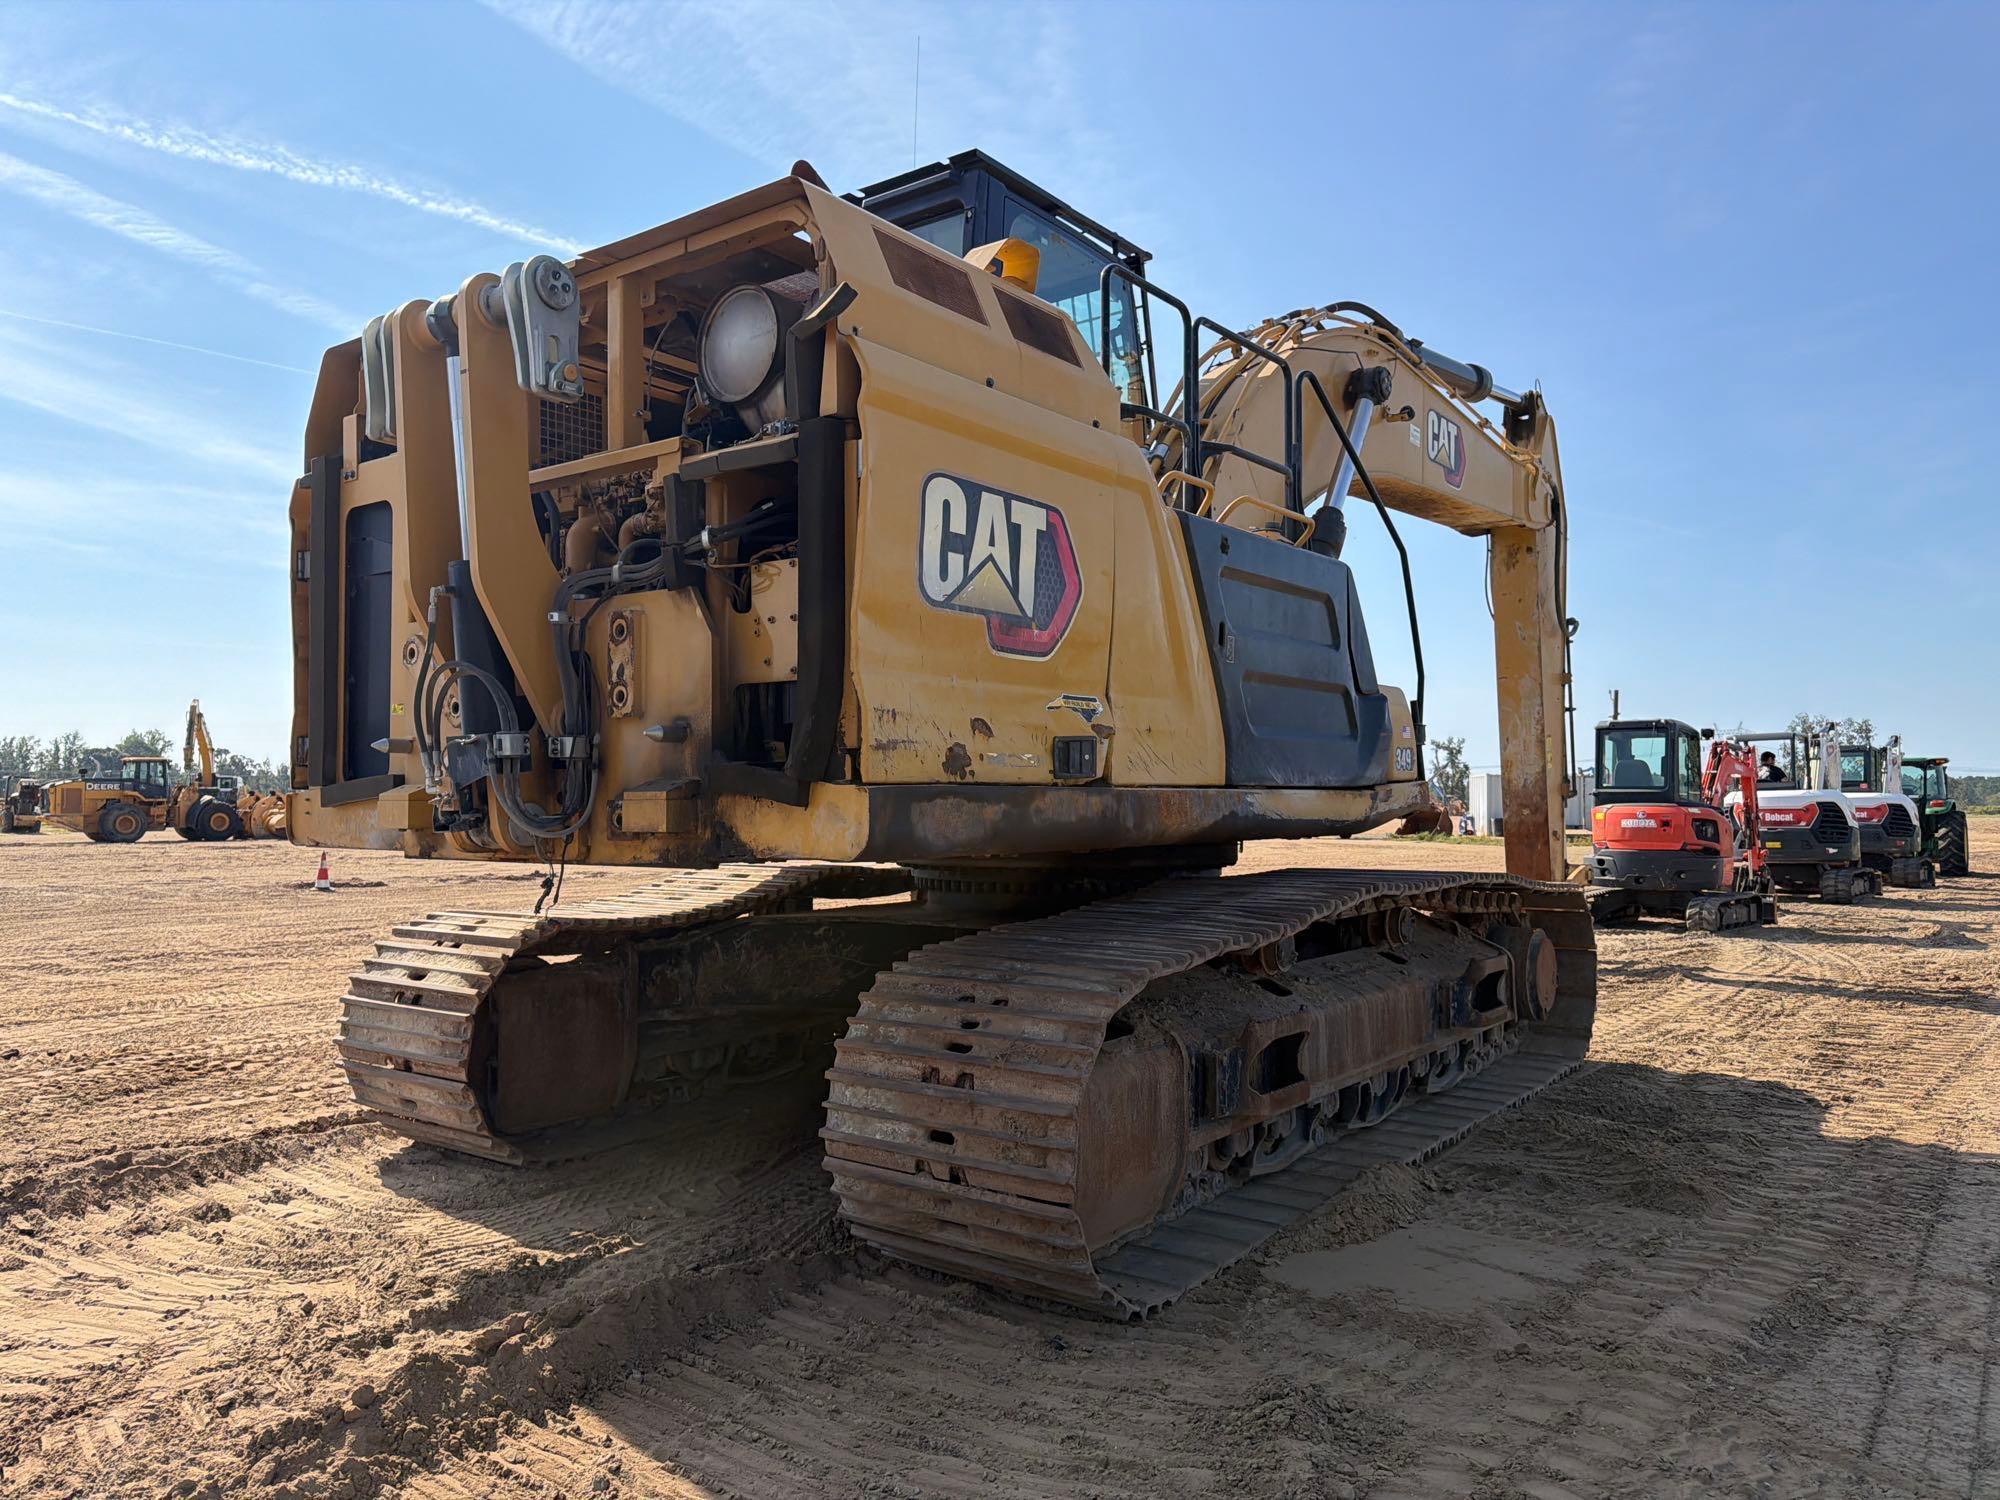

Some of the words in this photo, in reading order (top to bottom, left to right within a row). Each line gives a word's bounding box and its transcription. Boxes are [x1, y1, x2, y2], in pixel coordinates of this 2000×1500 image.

[1428, 410, 1457, 470] CAT
[922, 477, 1047, 618] CAT
[1396, 748, 1411, 770] 349
[86, 782, 120, 790] DEERE
[1765, 813, 1793, 821] Bobcat
